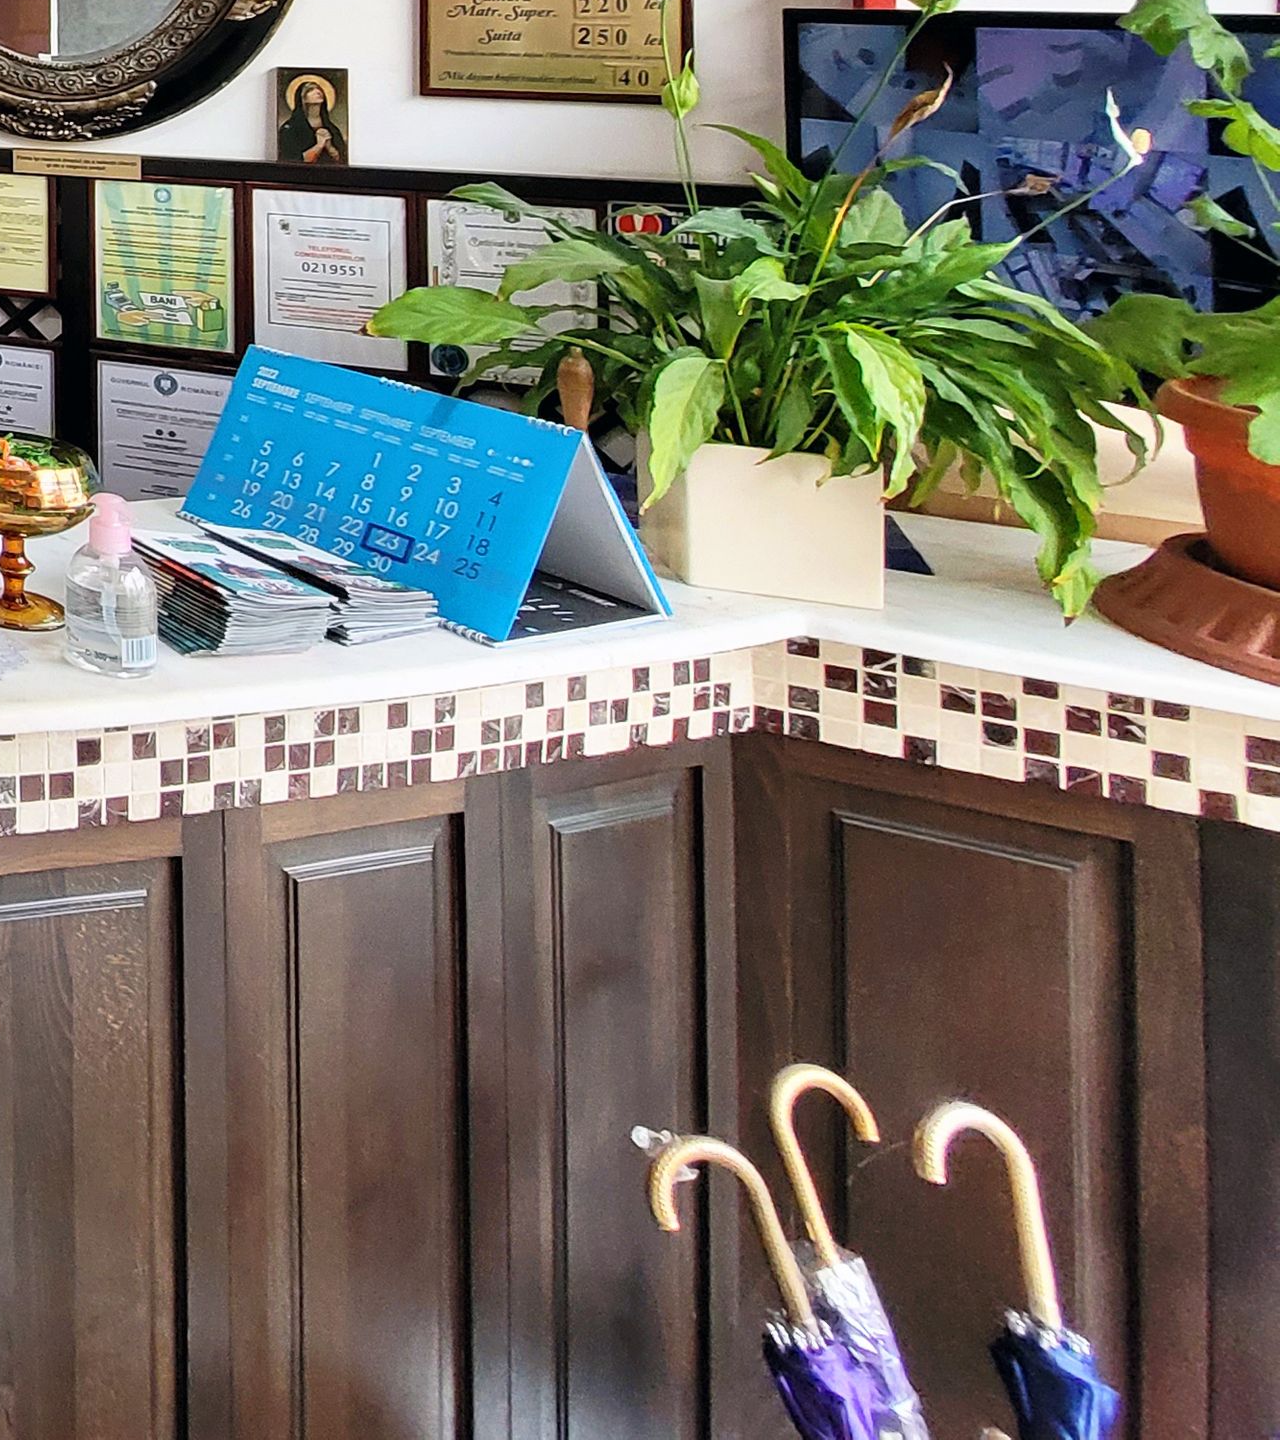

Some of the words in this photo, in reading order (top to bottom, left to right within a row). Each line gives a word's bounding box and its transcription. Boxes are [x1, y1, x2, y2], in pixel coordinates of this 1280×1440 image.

[446, 4, 503, 18] Matr.
[504, 5, 558, 22] Super.
[577, 27, 628, 46] 250
[617, 69, 650, 87] 40
[301, 261, 365, 277] 0219551
[149, 294, 178, 306] BANI
[259, 439, 274, 456] 5
[292, 451, 305, 467] 6
[325, 461, 341, 477] 7
[360, 473, 376, 491] 8
[400, 486, 414, 502] 9
[434, 497, 460, 520] 10
[475, 510, 498, 533] 11
[372, 451, 383, 469] 1
[406, 463, 423, 483] 2
[446, 476, 462, 495] 3
[487, 491, 504, 508] 4
[250, 458, 270, 479] 12
[281, 469, 303, 490] 13
[315, 481, 337, 502] 14
[349, 493, 373, 515] 15
[386, 506, 410, 528] 16
[425, 519, 451, 541] 17
[466, 533, 491, 557] 18
[230, 498, 252, 519] 26
[262, 510, 288, 530] 27
[295, 523, 320, 544] 28
[331, 536, 356, 557] 29
[366, 551, 393, 574] 30
[241, 478, 262, 497] 19
[269, 489, 295, 511] 20
[303, 501, 328, 523] 21
[338, 515, 364, 537] 22
[374, 529, 400, 551] 23
[412, 542, 441, 565] 24
[452, 557, 483, 580] 25
